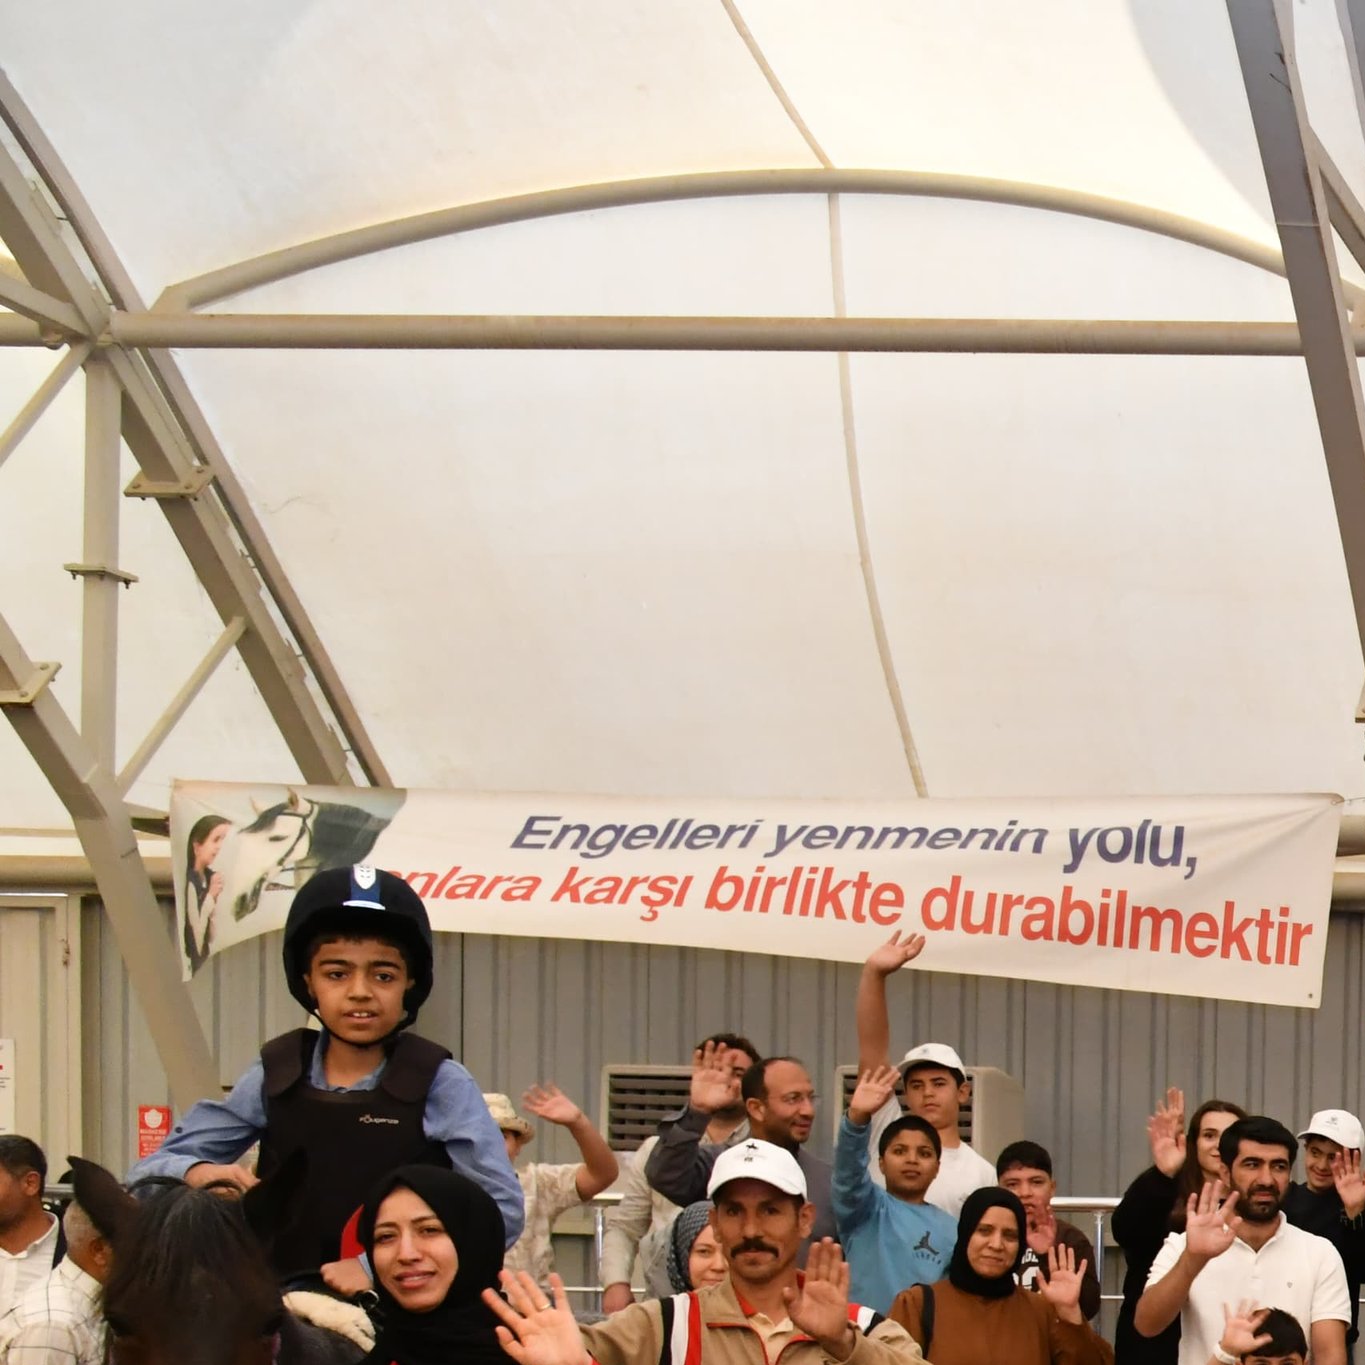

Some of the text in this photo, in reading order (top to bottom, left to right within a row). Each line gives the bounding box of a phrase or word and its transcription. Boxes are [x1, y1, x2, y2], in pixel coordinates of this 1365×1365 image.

[510, 815, 1198, 880] Engelleri yenmenin yolu,
[387, 866, 1313, 967] nlara karşı birlikte durabilmektir
